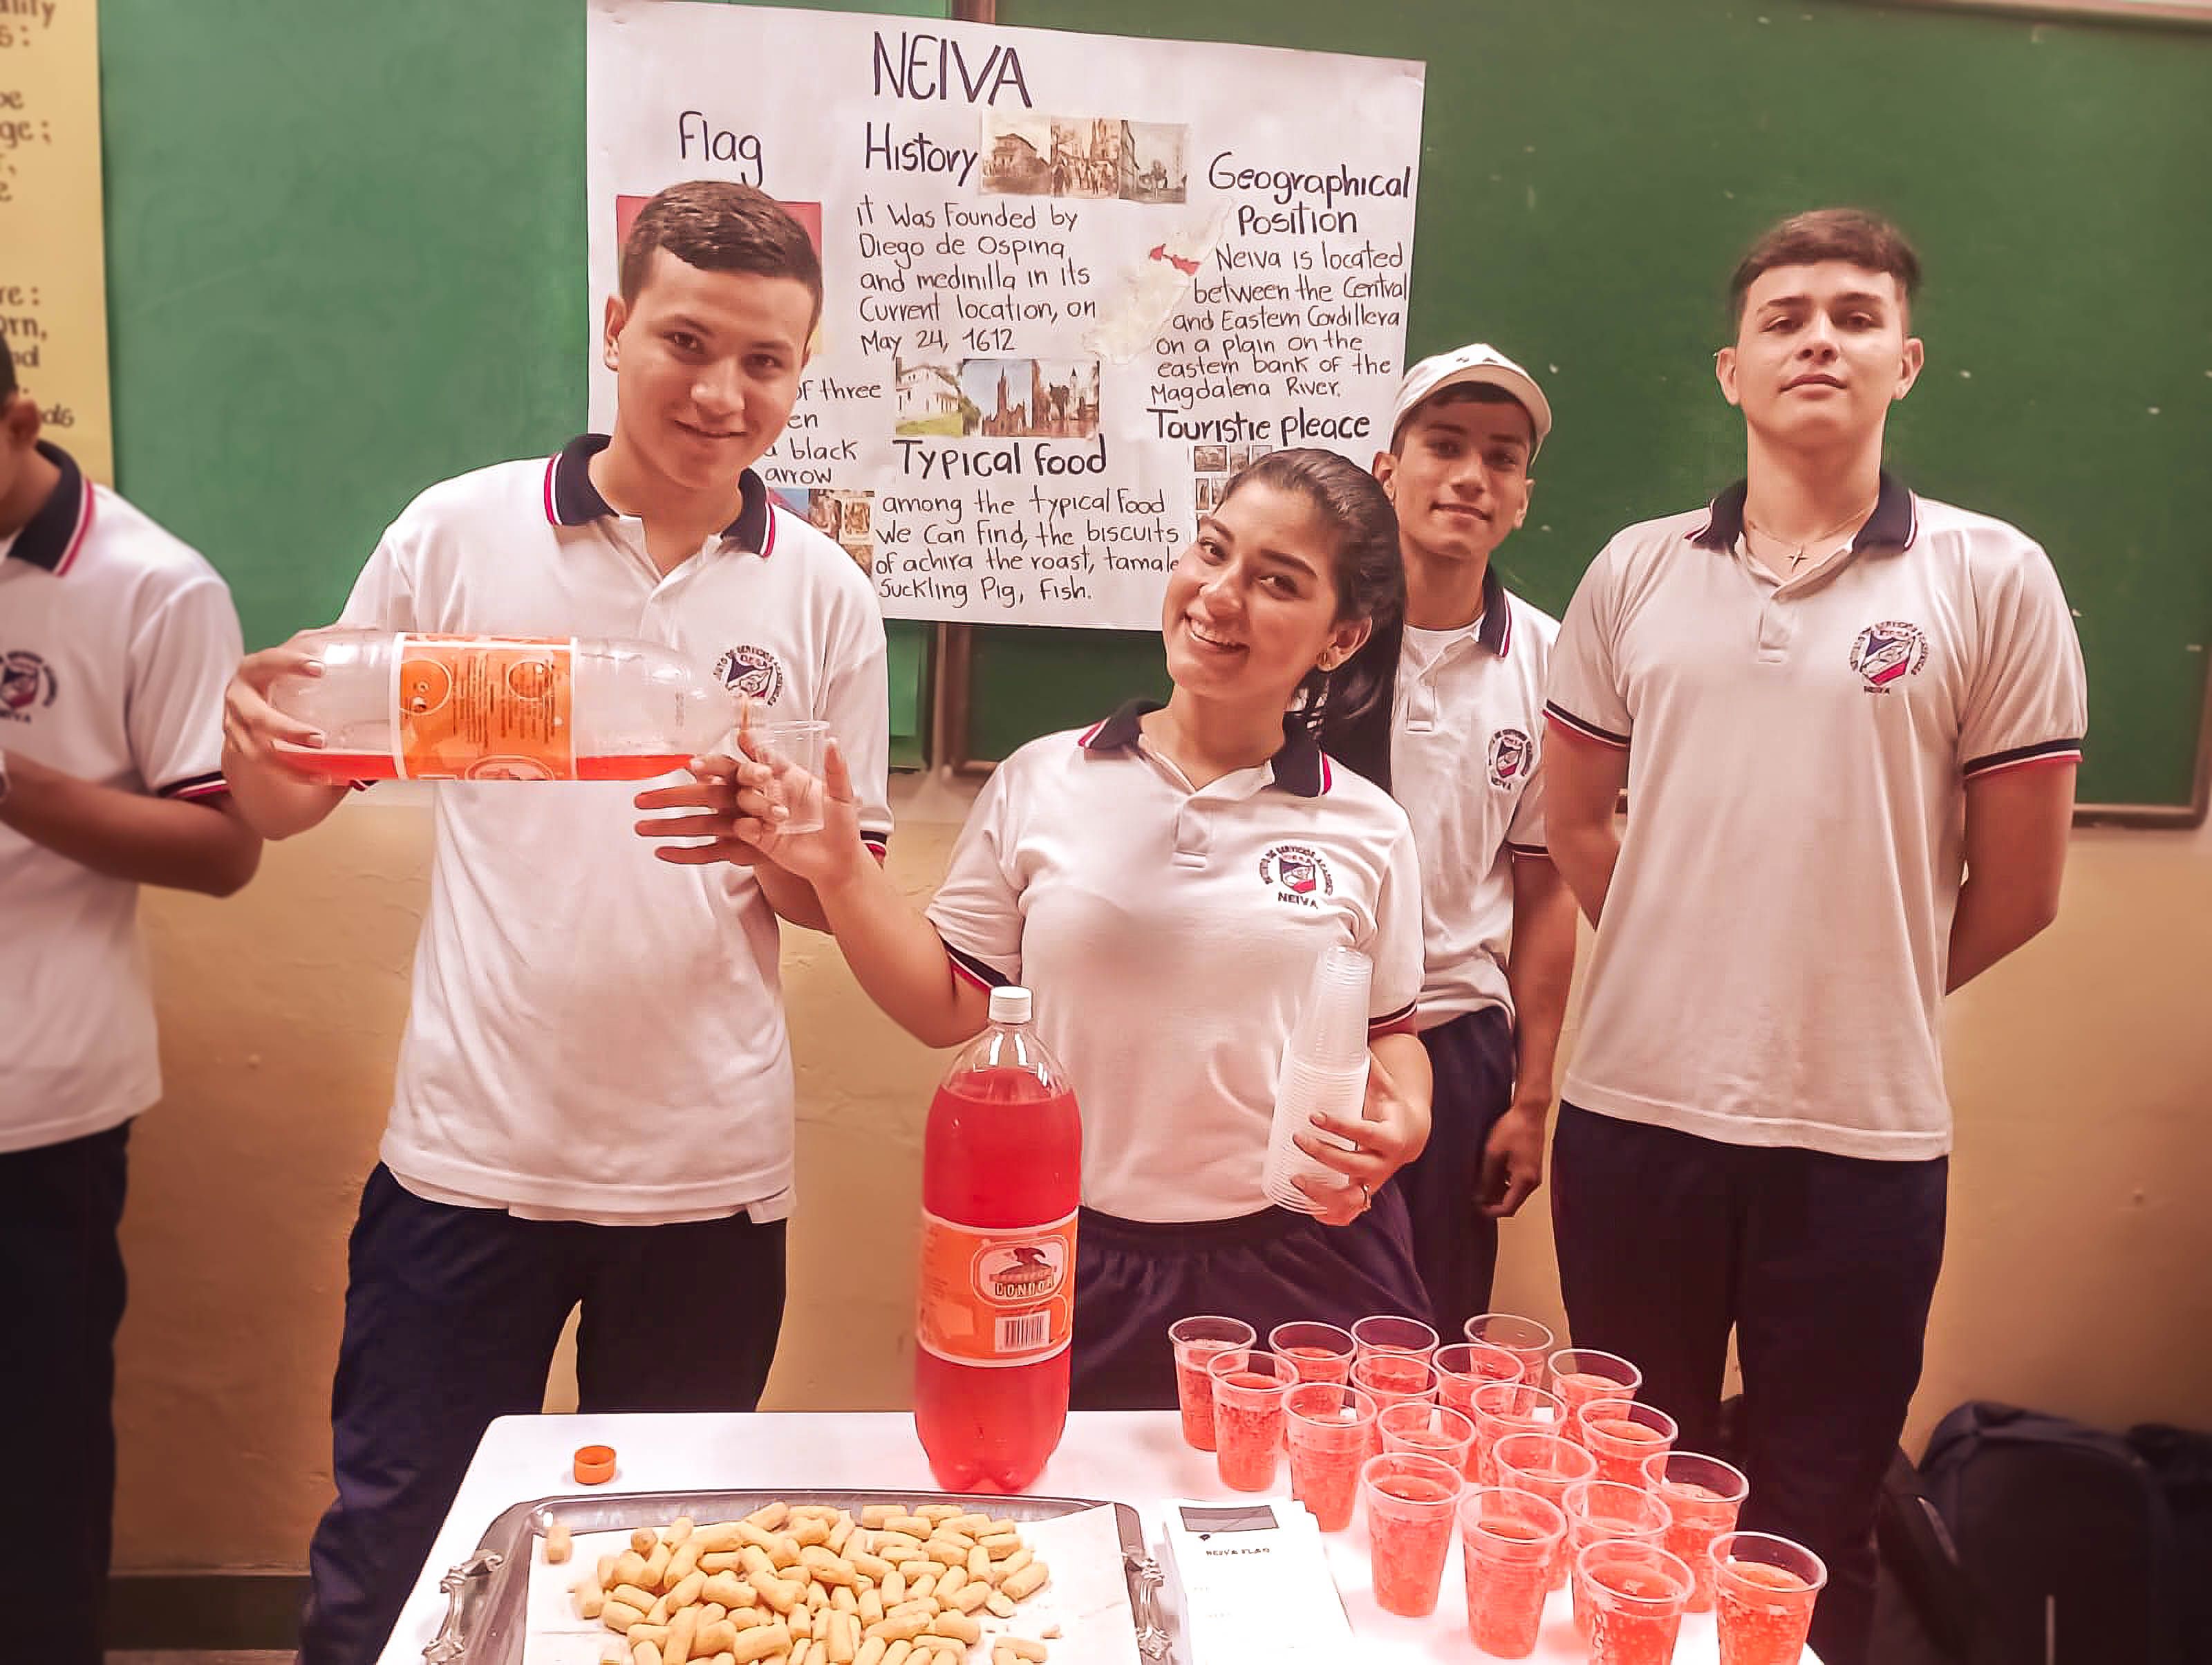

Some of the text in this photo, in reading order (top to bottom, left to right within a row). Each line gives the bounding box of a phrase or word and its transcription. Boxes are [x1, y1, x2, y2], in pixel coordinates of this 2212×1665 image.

[874, 30, 1033, 109] NEIVA
[865, 121, 978, 187] History
[1209, 151, 1411, 209] Geographical
[1050, 203, 1078, 232] by
[1238, 201, 1358, 236] Position
[859, 232, 1065, 270] Diego de Ospina
[1215, 239, 1404, 271] Neiva is located
[860, 257, 1091, 292] and medinilla in its
[1194, 271, 1407, 304] between the Central
[859, 291, 1096, 324] Current location, on
[1172, 302, 1400, 333] and Eastern Cordillera
[860, 326, 1018, 361] May 24, 1612
[1156, 329, 1363, 360] on a plain on the
[1156, 353, 1239, 379] eastern
[1251, 353, 1309, 375] bank
[1351, 356, 1391, 375] the
[818, 376, 883, 402] three
[1150, 375, 1341, 410] Magdalena River.
[1280, 407, 1371, 447] pleace
[789, 436, 859, 461] black
[892, 438, 1022, 480] Typical
[764, 466, 832, 485] arrow
[882, 495, 963, 525] among
[973, 487, 1016, 516] the
[1029, 483, 1110, 522] typical
[1034, 520, 1075, 548] the
[1086, 519, 1180, 545] biscuits
[875, 551, 899, 575] of
[985, 546, 1024, 572] the
[1030, 550, 1096, 575] roast,
[878, 577, 969, 608] Suckling
[981, 575, 1024, 609] Pig,
[1277, 891, 1319, 910] NEIVA
